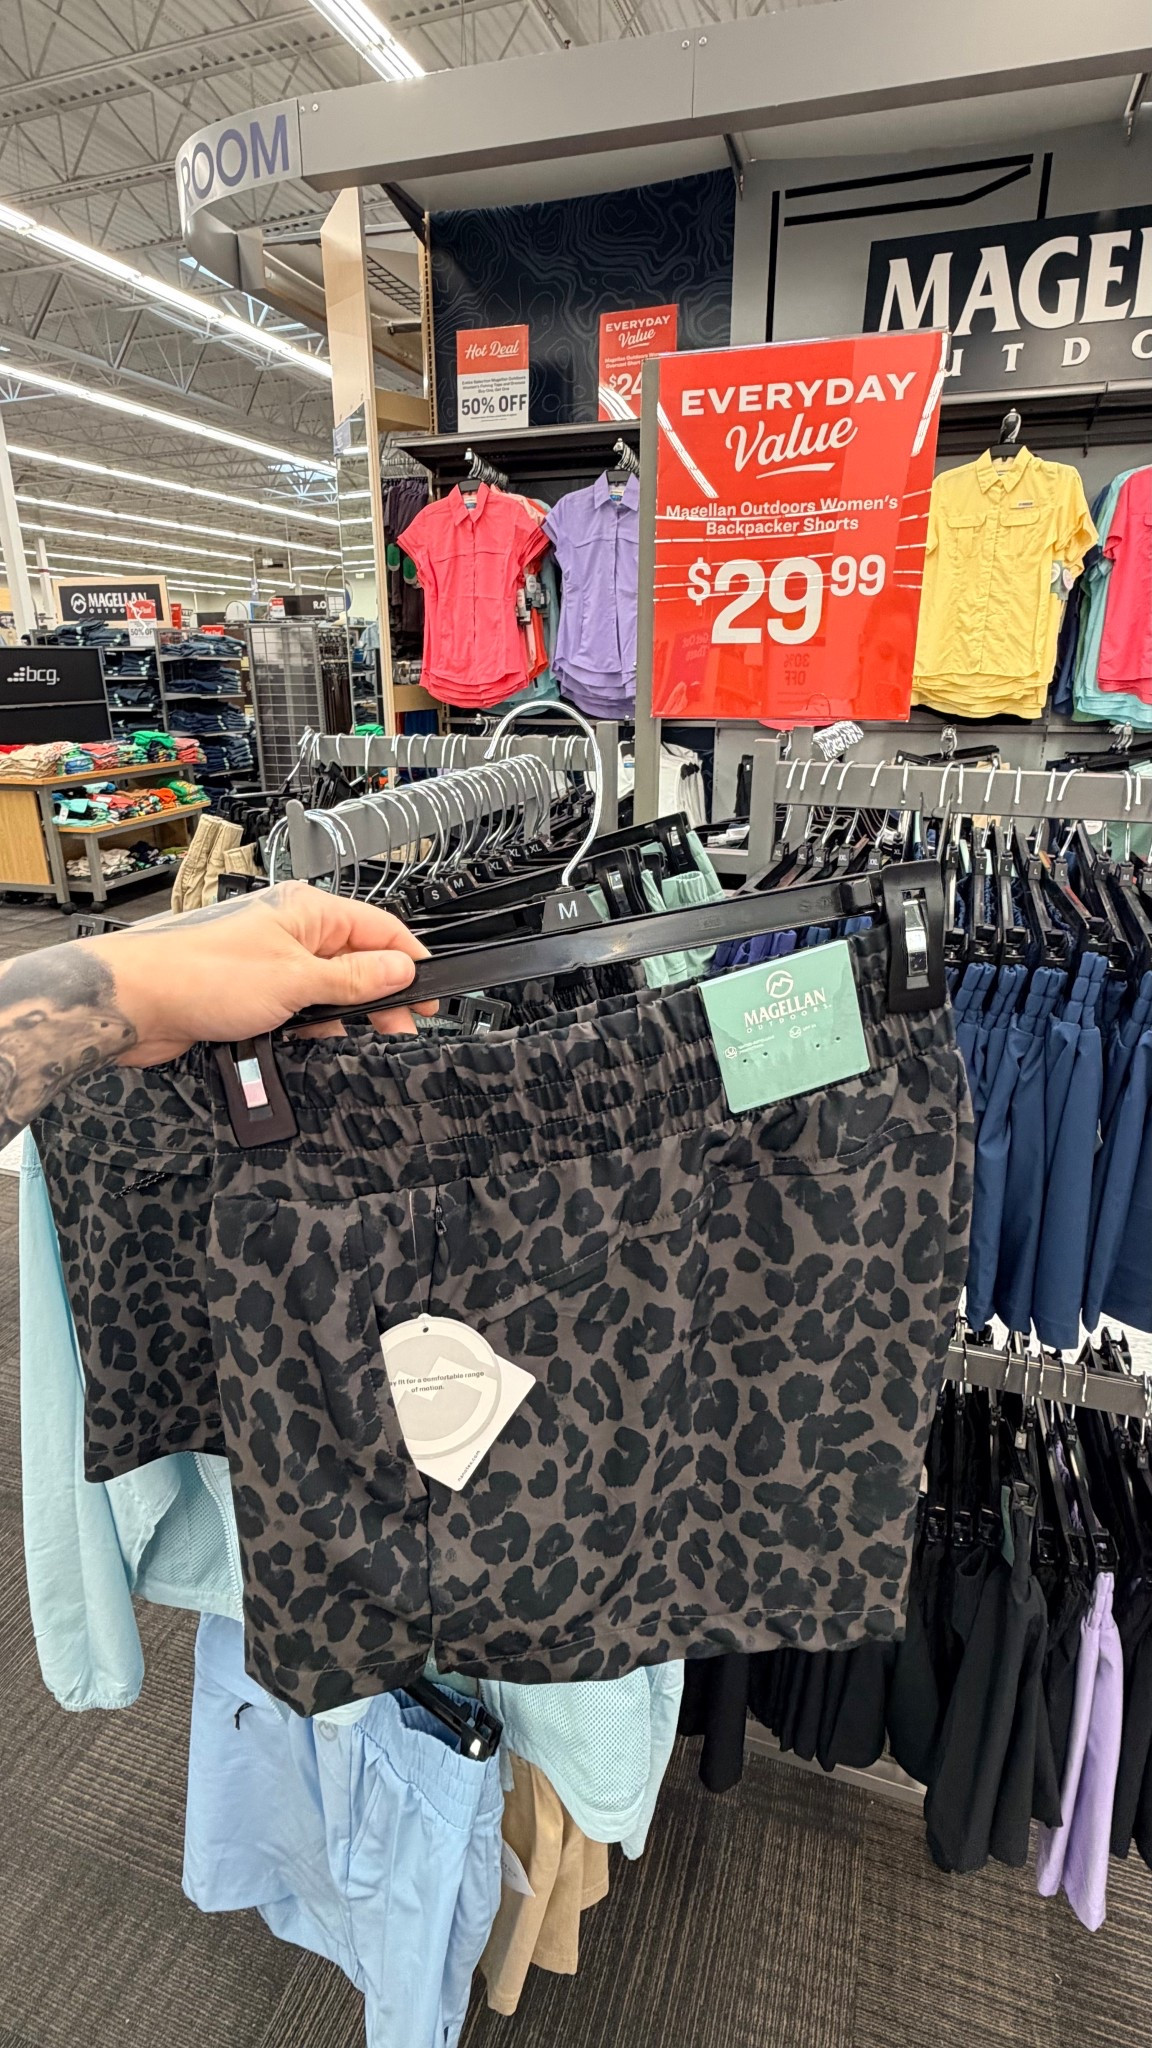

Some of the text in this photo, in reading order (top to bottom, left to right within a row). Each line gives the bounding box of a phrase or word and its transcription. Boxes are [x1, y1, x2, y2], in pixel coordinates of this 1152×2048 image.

[181, 114, 289, 212] ROOM
[605, 315, 671, 333] EVERYDAY
[618, 328, 656, 349] Value
[465, 340, 520, 360] Hot Deal
[944, 329, 1152, 378] UTDO
[681, 371, 917, 416] EVERYDAY
[461, 393, 527, 416] 50% OFF
[725, 413, 858, 473] Value
[666, 495, 898, 520] Magellan Outdoors Women's
[706, 516, 859, 536] Backpacker Shorts
[509, 848, 521, 857] XL
[529, 843, 542, 853] XL
[475, 867, 481, 876] L
[490, 861, 503, 870] XL
[453, 878, 464, 889] M
[431, 889, 440, 900] S
[557, 900, 578, 920] M
[743, 987, 827, 1028] MAGELLAN
[406, 1376, 416, 1384] for
[422, 1373, 464, 1383] comfortable
[464, 1371, 485, 1379] range
